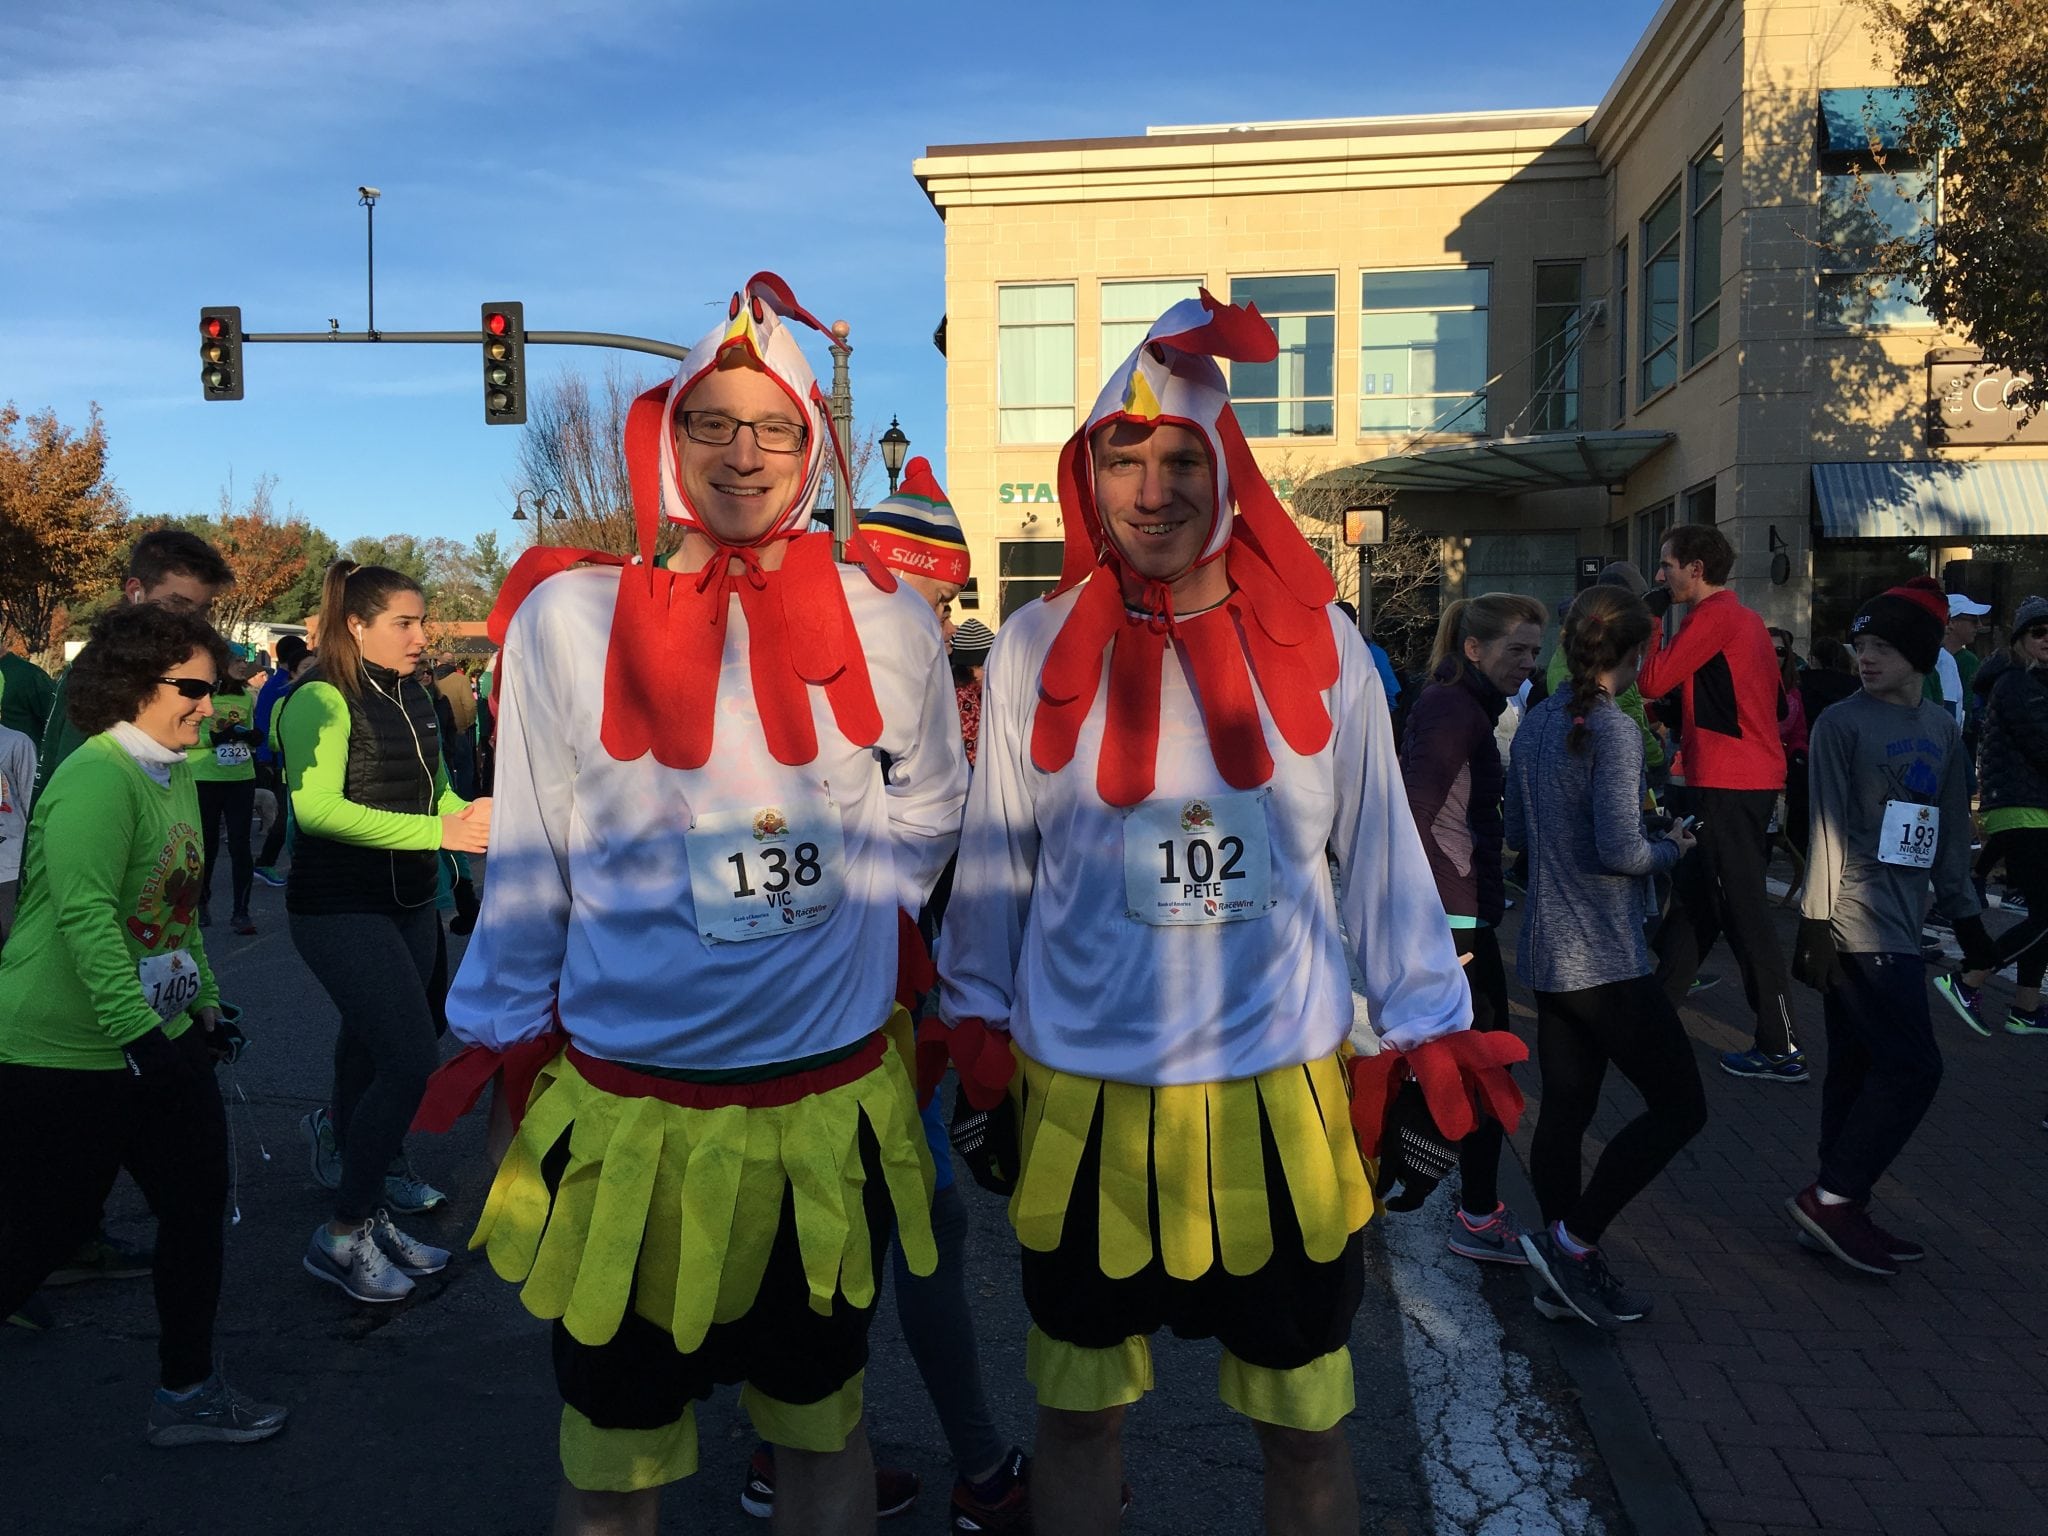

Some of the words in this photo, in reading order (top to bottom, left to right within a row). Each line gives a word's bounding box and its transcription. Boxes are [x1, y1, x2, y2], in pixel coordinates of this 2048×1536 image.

[1944, 378, 1964, 413] the
[1972, 377, 2032, 413] CO
[999, 482, 1056, 504] STA
[219, 747, 249, 758] 2323
[1900, 823, 1935, 848] 193
[728, 842, 822, 898] 138
[1158, 836, 1246, 884] 102
[766, 891, 792, 908] VIC
[1183, 882, 1223, 899] PETE
[795, 904, 828, 918] RaceWire
[1218, 900, 1254, 911] RaceWire
[152, 972, 198, 1009] 1405
